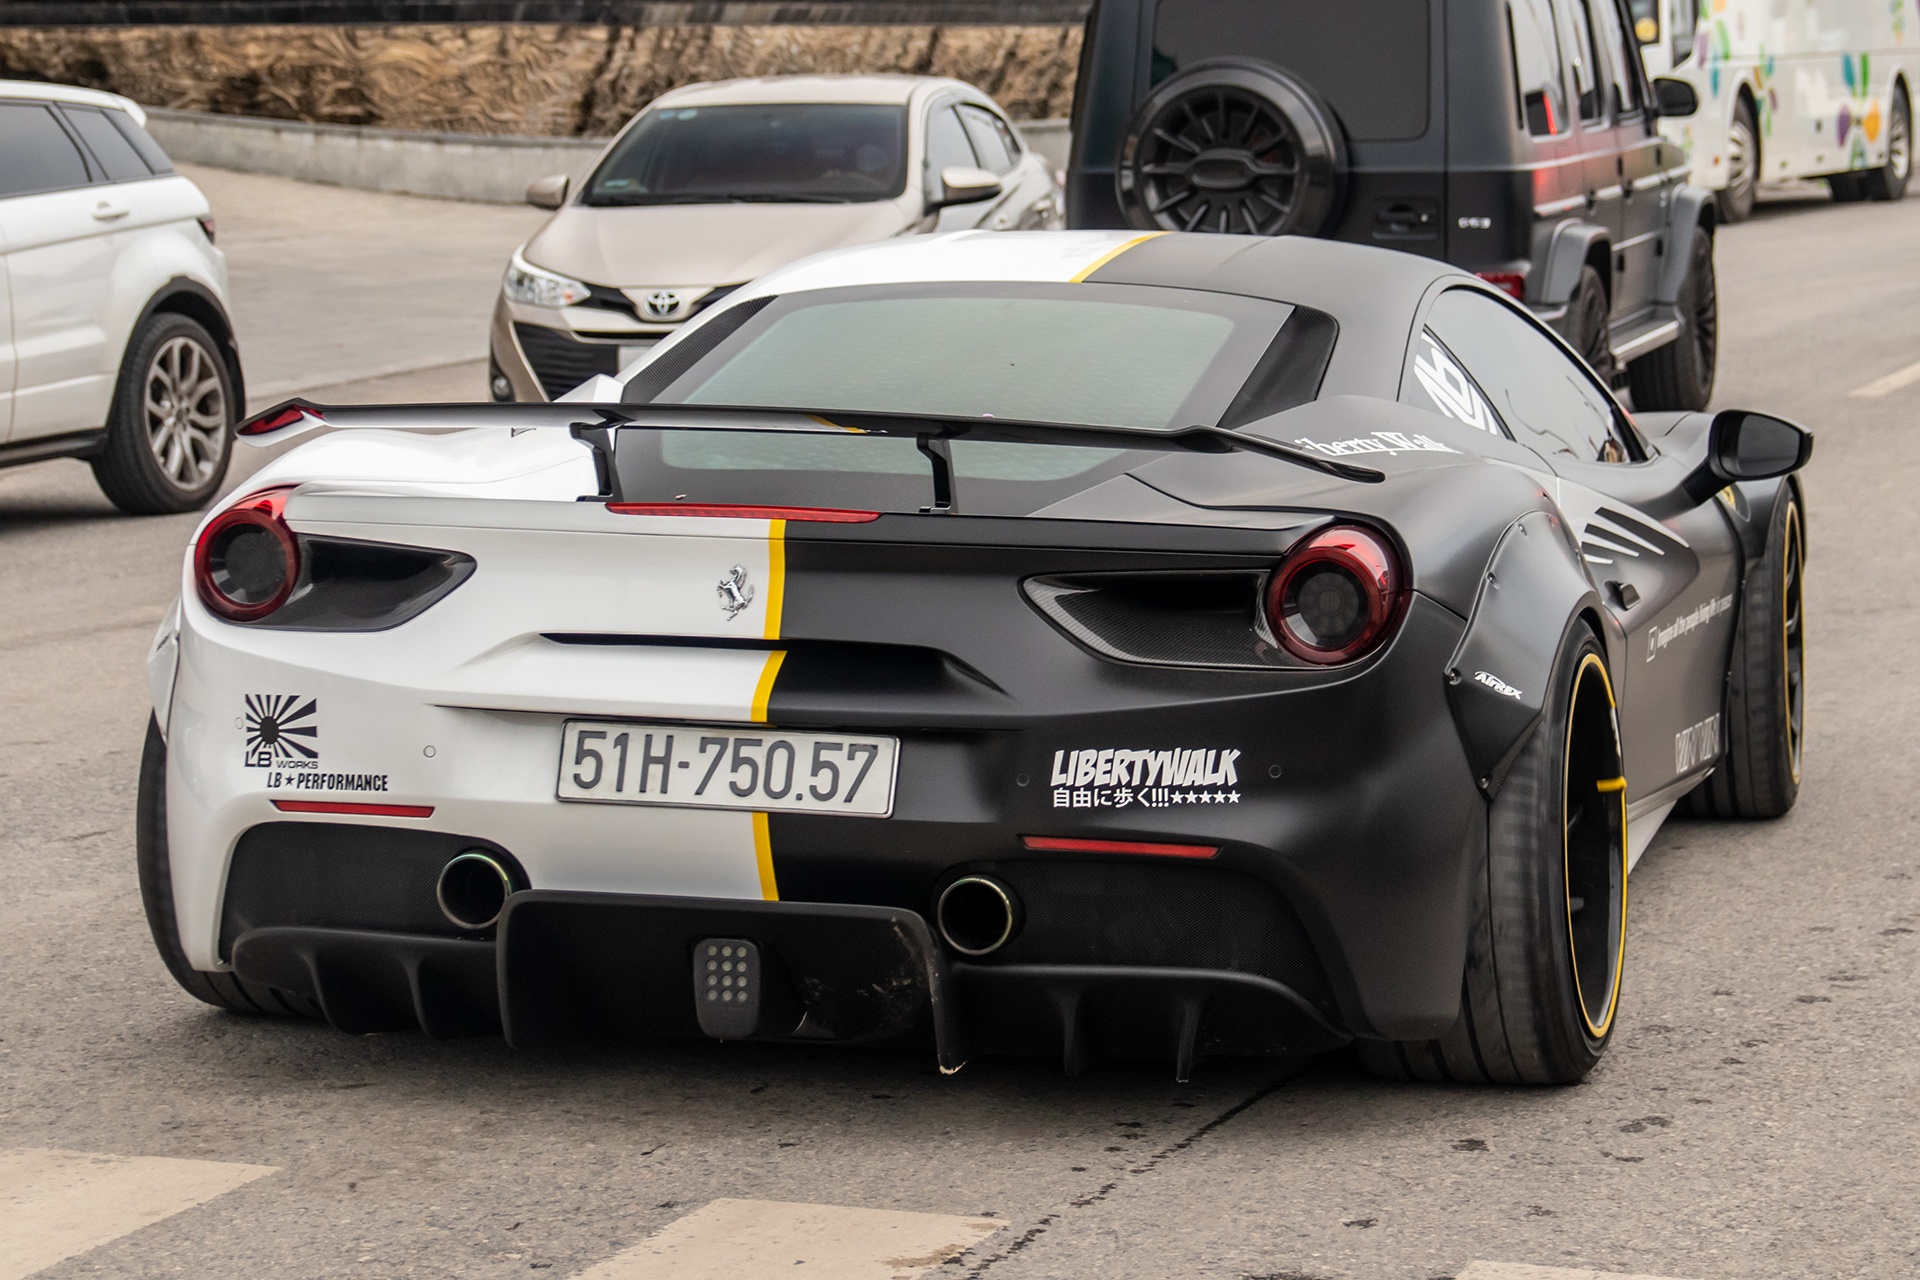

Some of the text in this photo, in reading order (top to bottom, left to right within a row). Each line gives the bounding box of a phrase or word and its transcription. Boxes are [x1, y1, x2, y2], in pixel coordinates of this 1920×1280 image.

[244, 751, 319, 769] LB WORKS
[573, 729, 879, 804] 51H-750.57
[266, 772, 388, 792] LB PERFORMANCE
